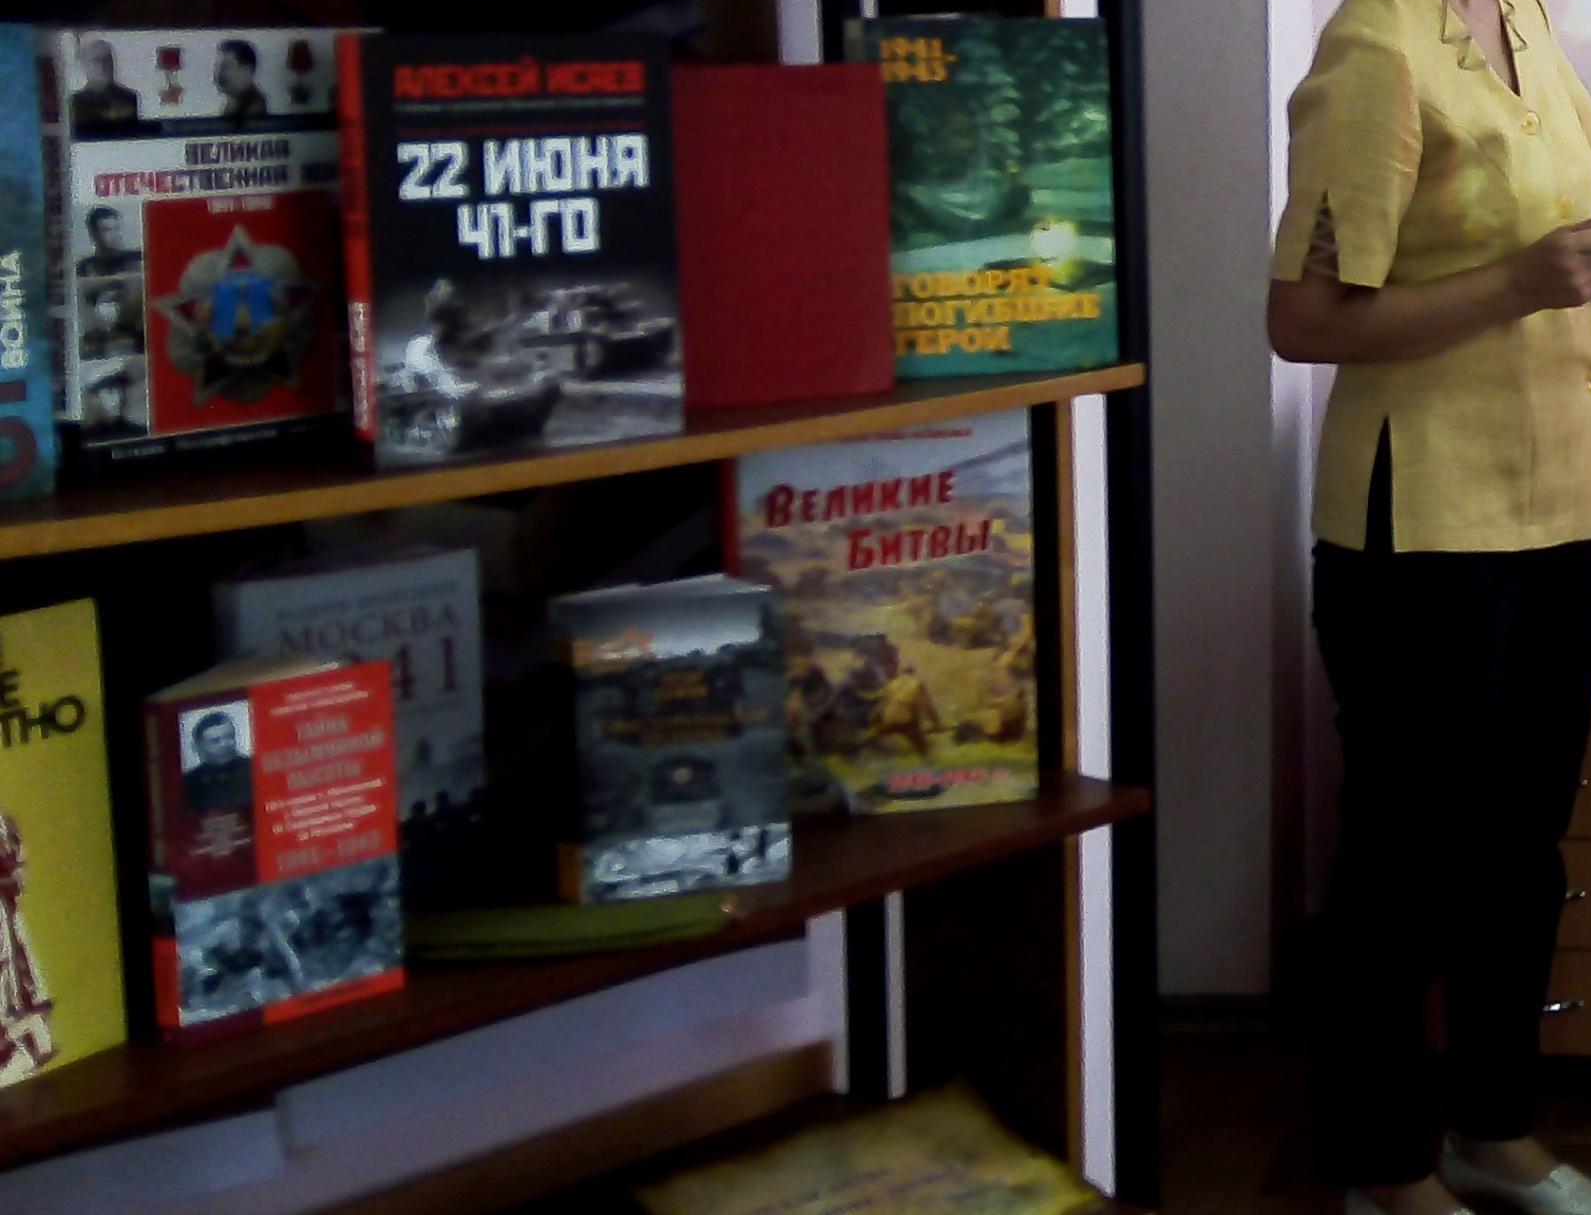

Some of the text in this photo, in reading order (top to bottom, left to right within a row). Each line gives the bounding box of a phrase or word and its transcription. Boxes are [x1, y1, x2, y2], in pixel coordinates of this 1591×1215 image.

[394, 56, 646, 99] АЛЕКСЕЙ ИСАЕВ
[185, 139, 290, 166] ВЕЛИКАЯ
[395, 140, 470, 202] 22
[482, 132, 650, 197] ИЮНЯ
[94, 165, 289, 197] ОТЕЧЕСТВЕННАЯ
[456, 197, 602, 260] 41-ГО
[894, 326, 1012, 356] ГЕРОИ
[764, 467, 956, 529] ВЕЛИКИЕ
[846, 516, 993, 573] БИТВЫ
[279, 604, 461, 657] МОСКВА
